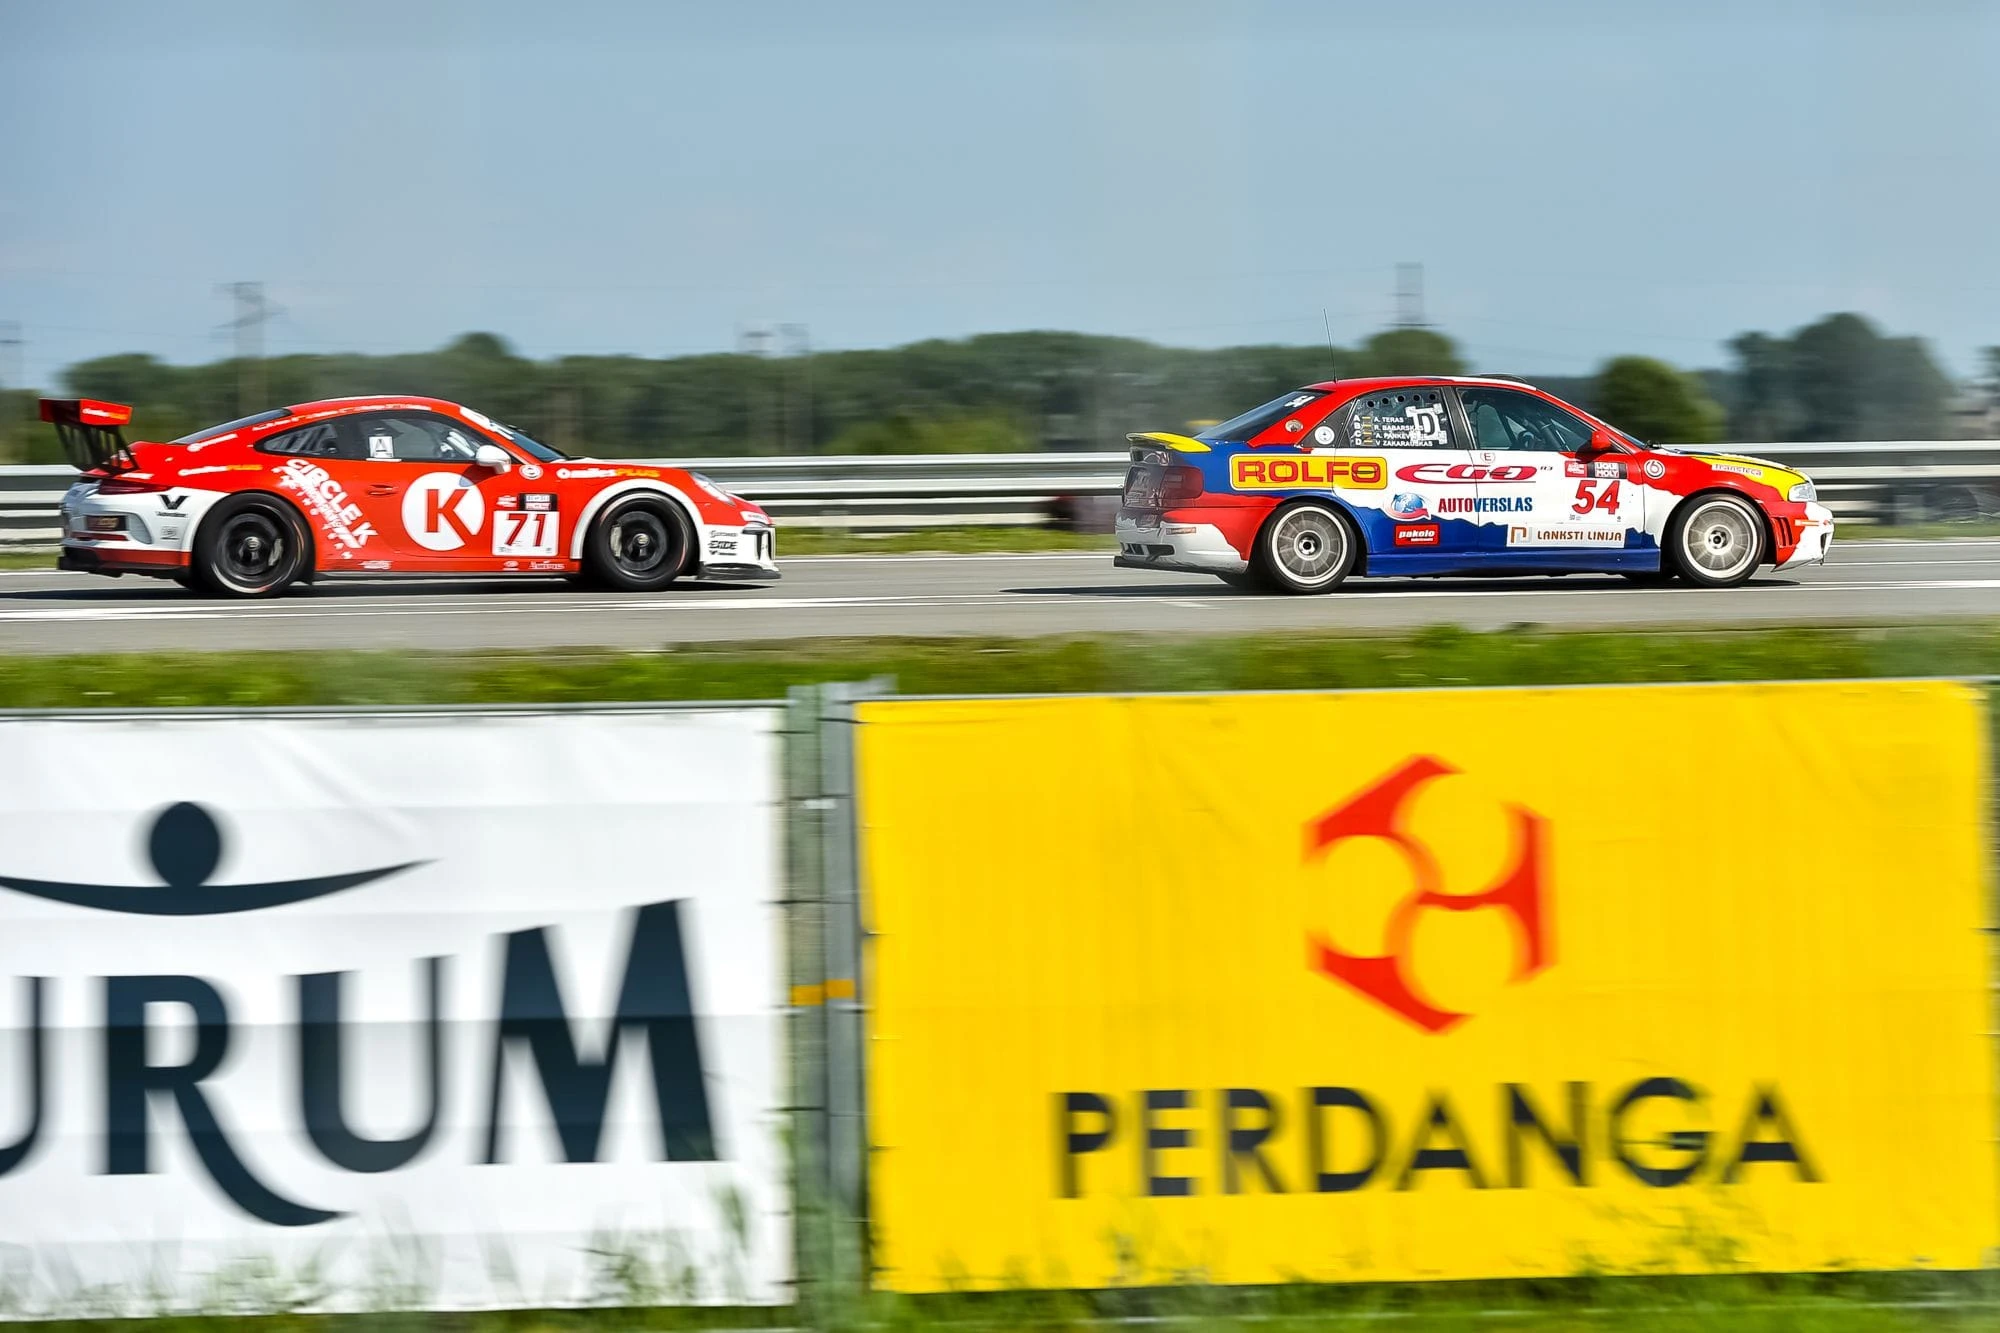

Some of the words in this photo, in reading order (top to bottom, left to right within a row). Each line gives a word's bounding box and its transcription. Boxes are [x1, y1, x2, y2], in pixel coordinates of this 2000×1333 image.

[1353, 414, 1360, 422] A
[1353, 422, 1361, 430] B
[1354, 430, 1362, 438] C
[1355, 438, 1362, 446] D
[1238, 460, 1381, 484] ROLFO
[286, 459, 362, 526] CIRCLE
[352, 522, 378, 546] K
[1571, 479, 1620, 515] 54
[1437, 496, 1533, 513] AUTOVERSLAS
[505, 513, 546, 547] 71
[1398, 530, 1436, 539] pakolo
[1537, 530, 1584, 541] LANKSTI
[1587, 531, 1622, 542] LINIJA
[1049, 1074, 1822, 1199] PERDANGA
